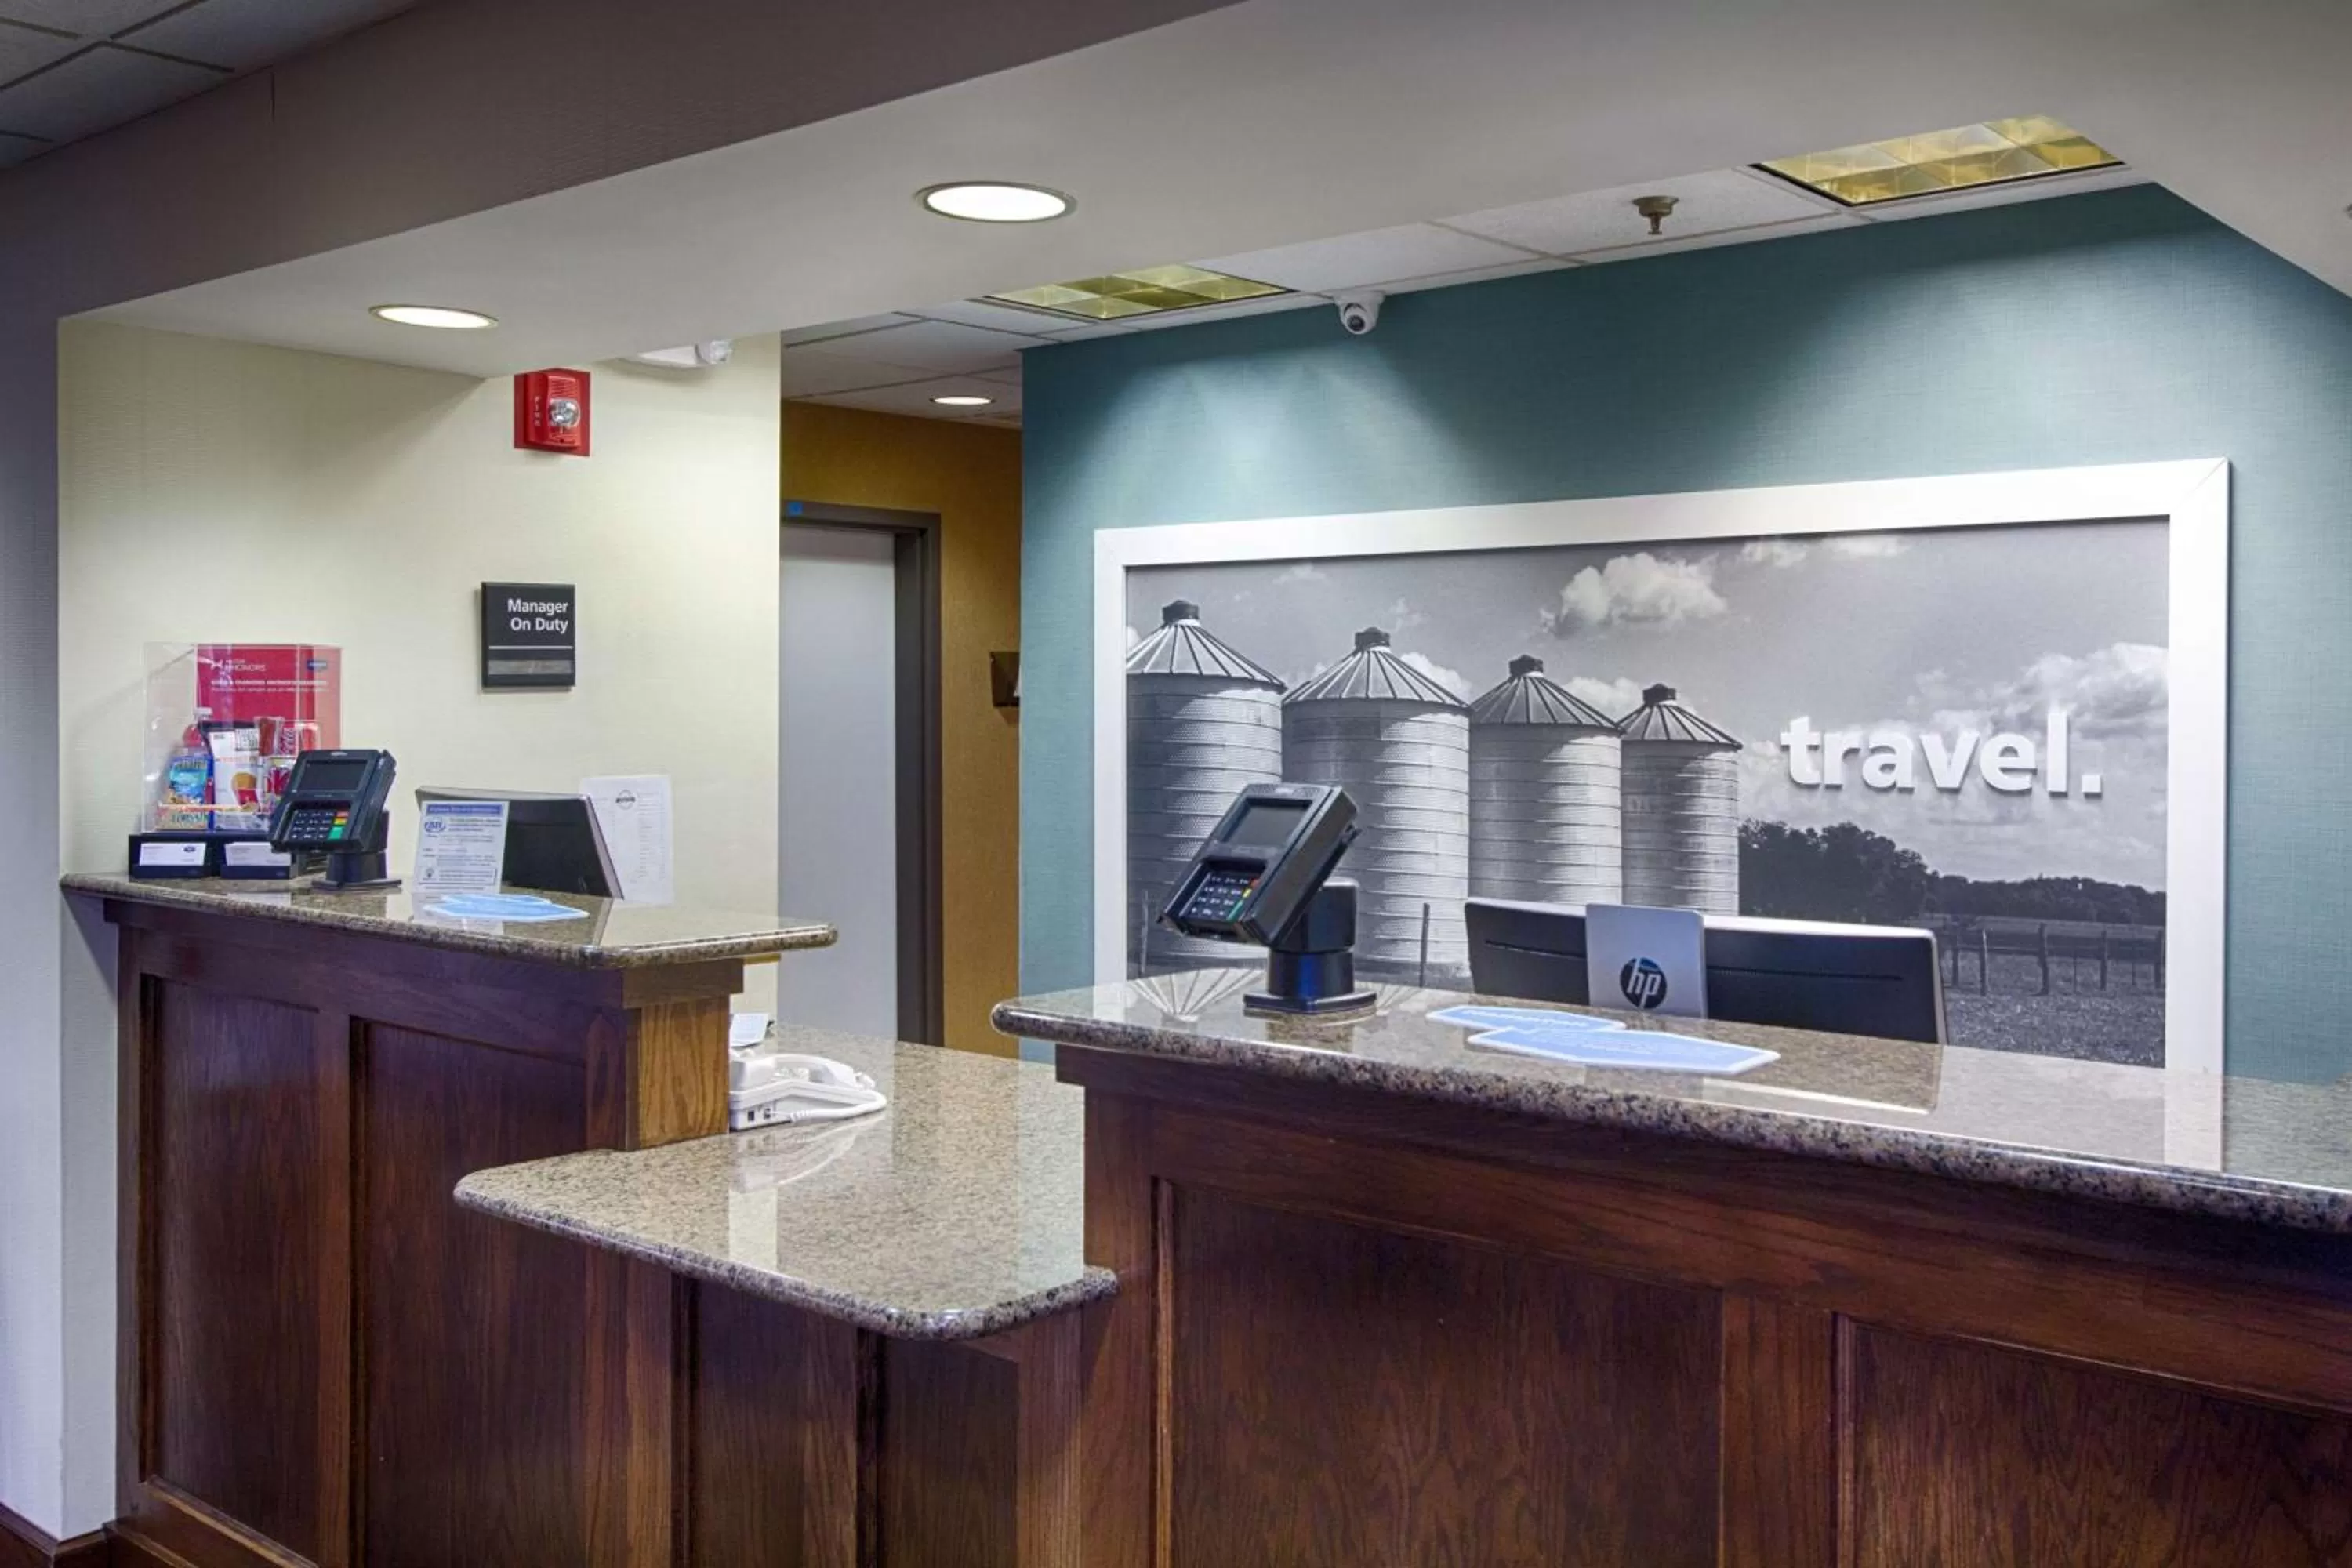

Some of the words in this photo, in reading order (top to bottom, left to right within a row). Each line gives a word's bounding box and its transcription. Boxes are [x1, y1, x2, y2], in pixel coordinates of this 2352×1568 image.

[507, 598, 568, 616] Manager
[510, 617, 531, 631] On
[535, 617, 568, 634] Duty
[1780, 712, 2103, 796] travel.
[1627, 957, 1662, 1009] hp
